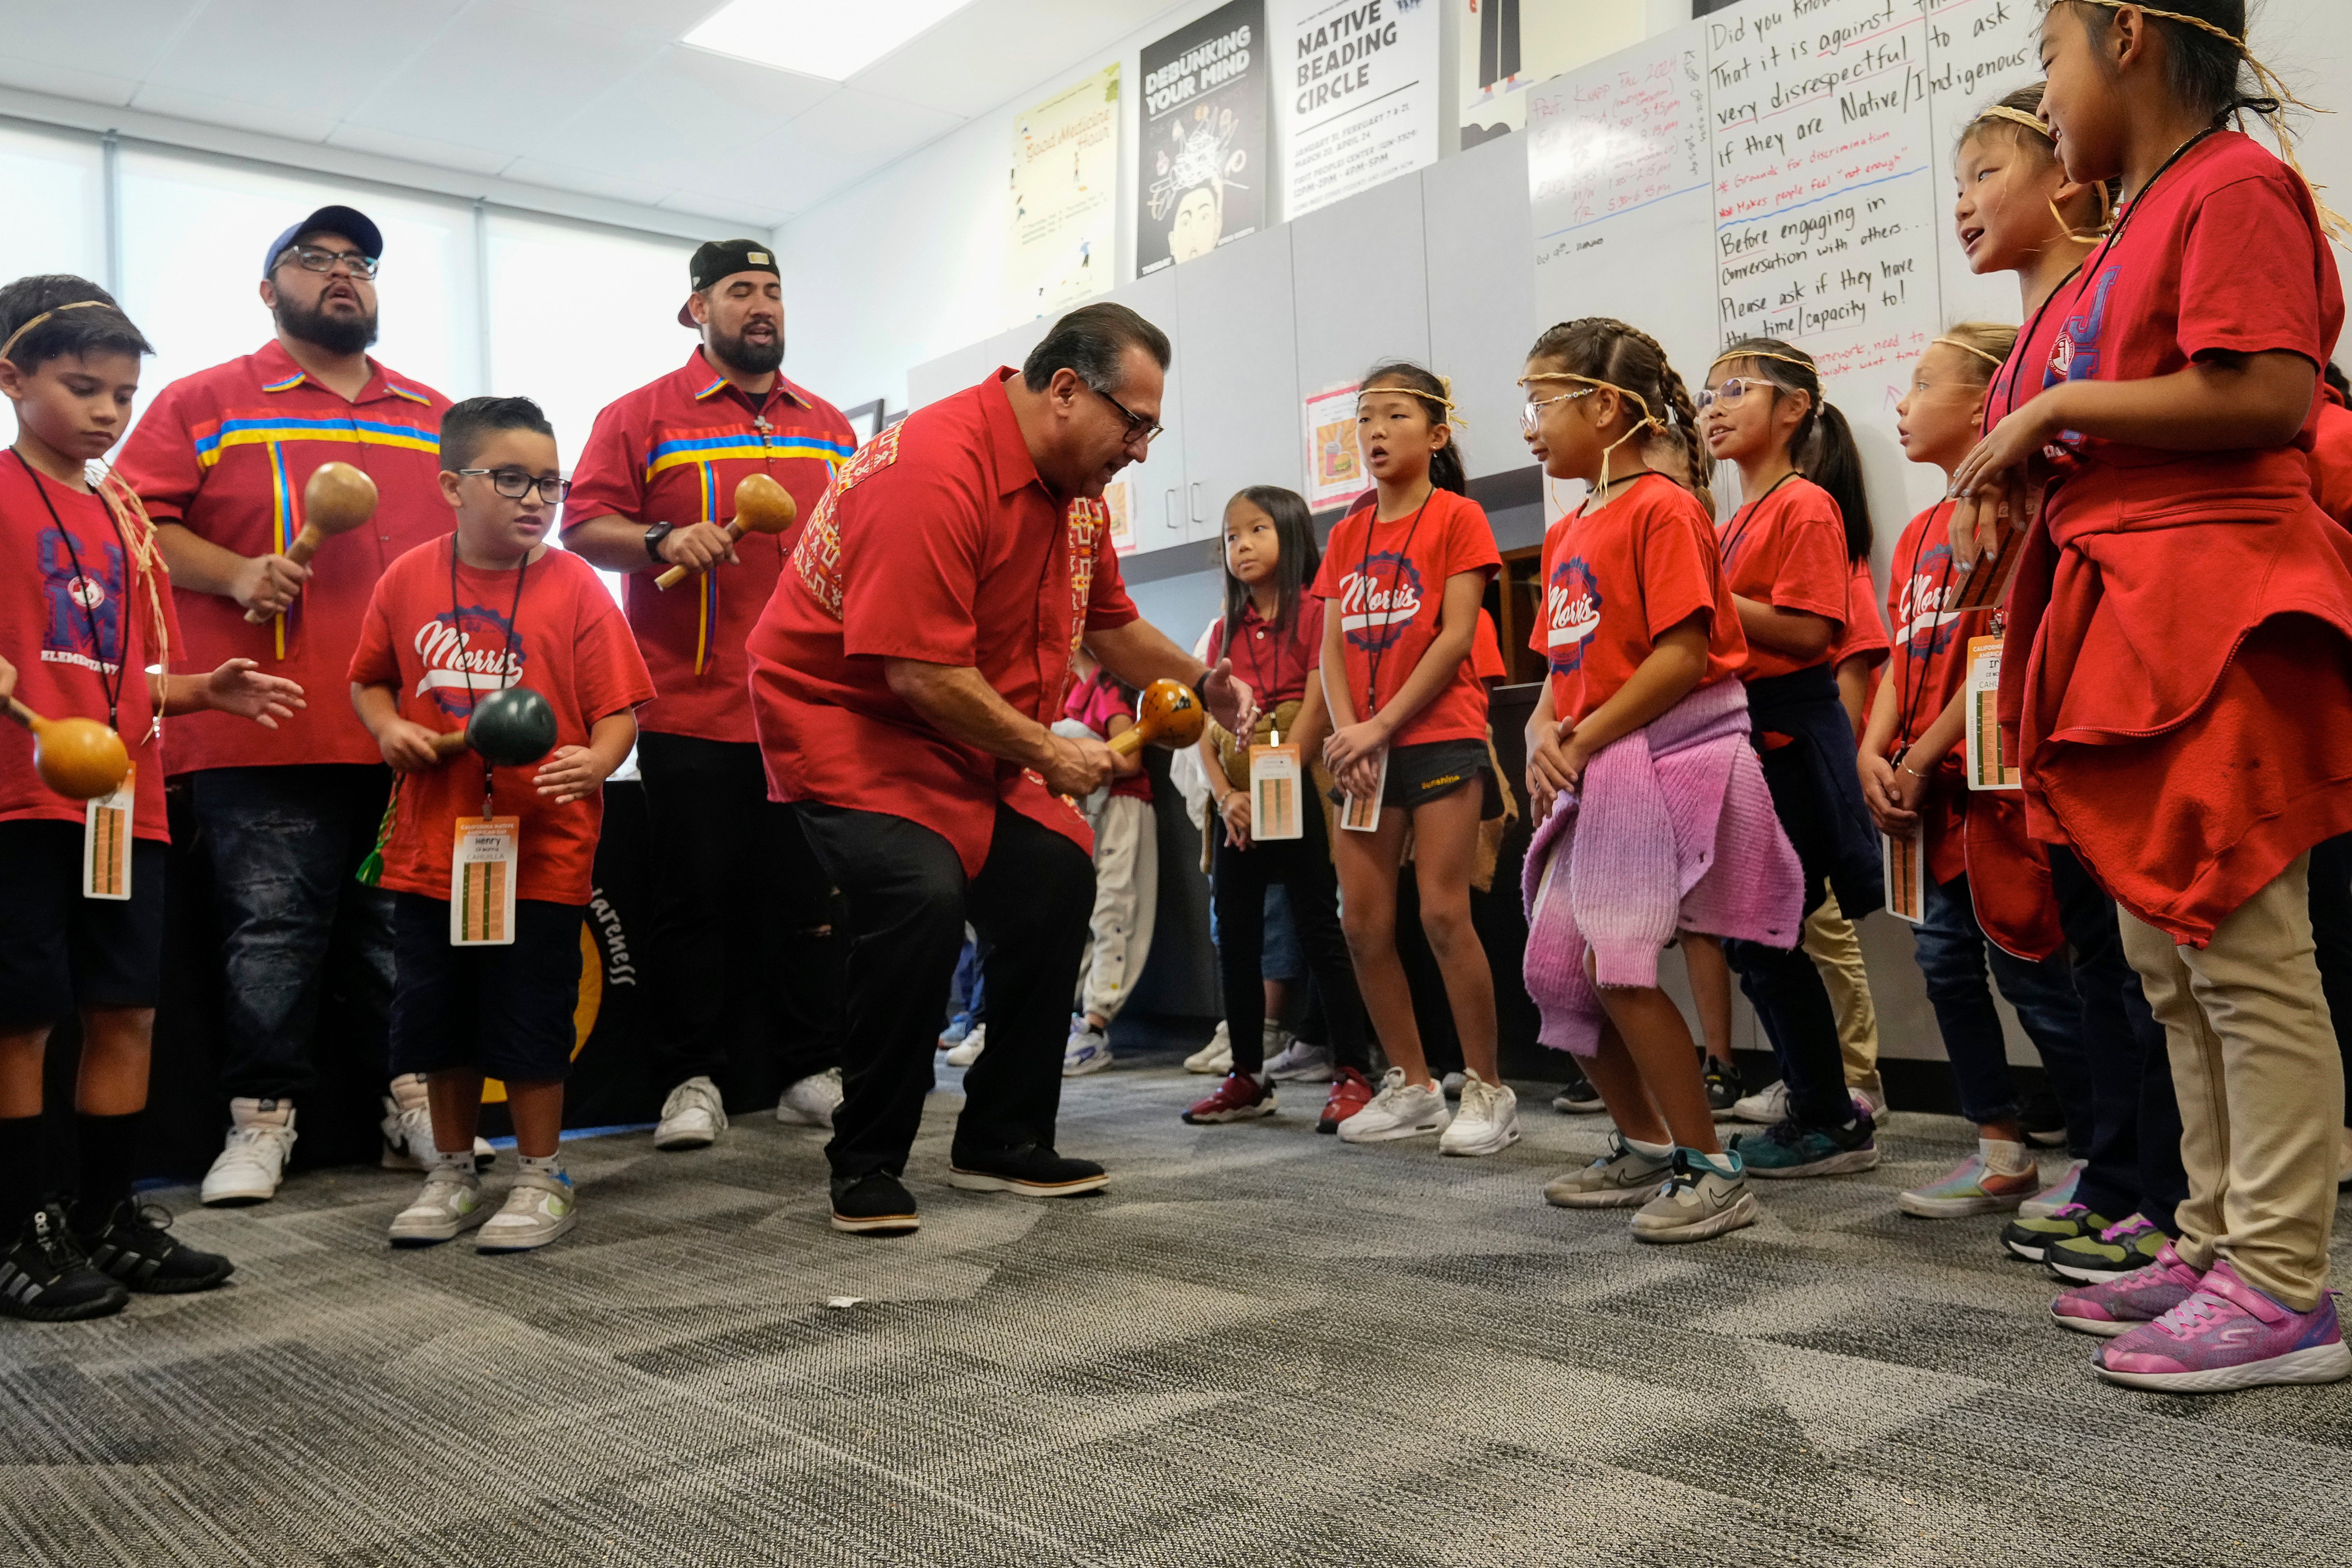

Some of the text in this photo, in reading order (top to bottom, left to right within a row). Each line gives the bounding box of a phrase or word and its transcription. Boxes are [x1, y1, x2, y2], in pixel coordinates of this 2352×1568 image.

[1298, 0, 1381, 59] NATIVE
[1298, 21, 1397, 87] BEADING
[1711, 57, 1751, 89] That
[1760, 46, 1780, 71] it
[1792, 41, 1807, 60] is
[1820, 0, 1894, 55] against
[1712, 17, 1745, 50] Did
[1754, 13, 1781, 43] you
[1145, 25, 1251, 95] DEBUNKING
[1145, 49, 1250, 115] YOUR MIND
[1296, 63, 1369, 114] CIRCLE
[1718, 2, 2011, 124] very disrespectful to ask
[1719, 48, 2027, 167] if they are Native/Indigenous
[1734, 165, 1778, 188] Grounds
[1787, 158, 1802, 172] for
[1809, 131, 1890, 163] discrimination
[1775, 184, 1803, 205] people
[1811, 176, 1831, 191] feel
[1721, 197, 1886, 257] Before engaging in
[1817, 238, 1848, 256] with
[1721, 258, 1914, 322] Please ask if they have
[1764, 300, 1866, 338] time/capacity
[1909, 331, 1923, 343] to
[1339, 572, 1416, 614] Morris
[414, 620, 519, 673] Morris
[590, 887, 637, 986] areness
